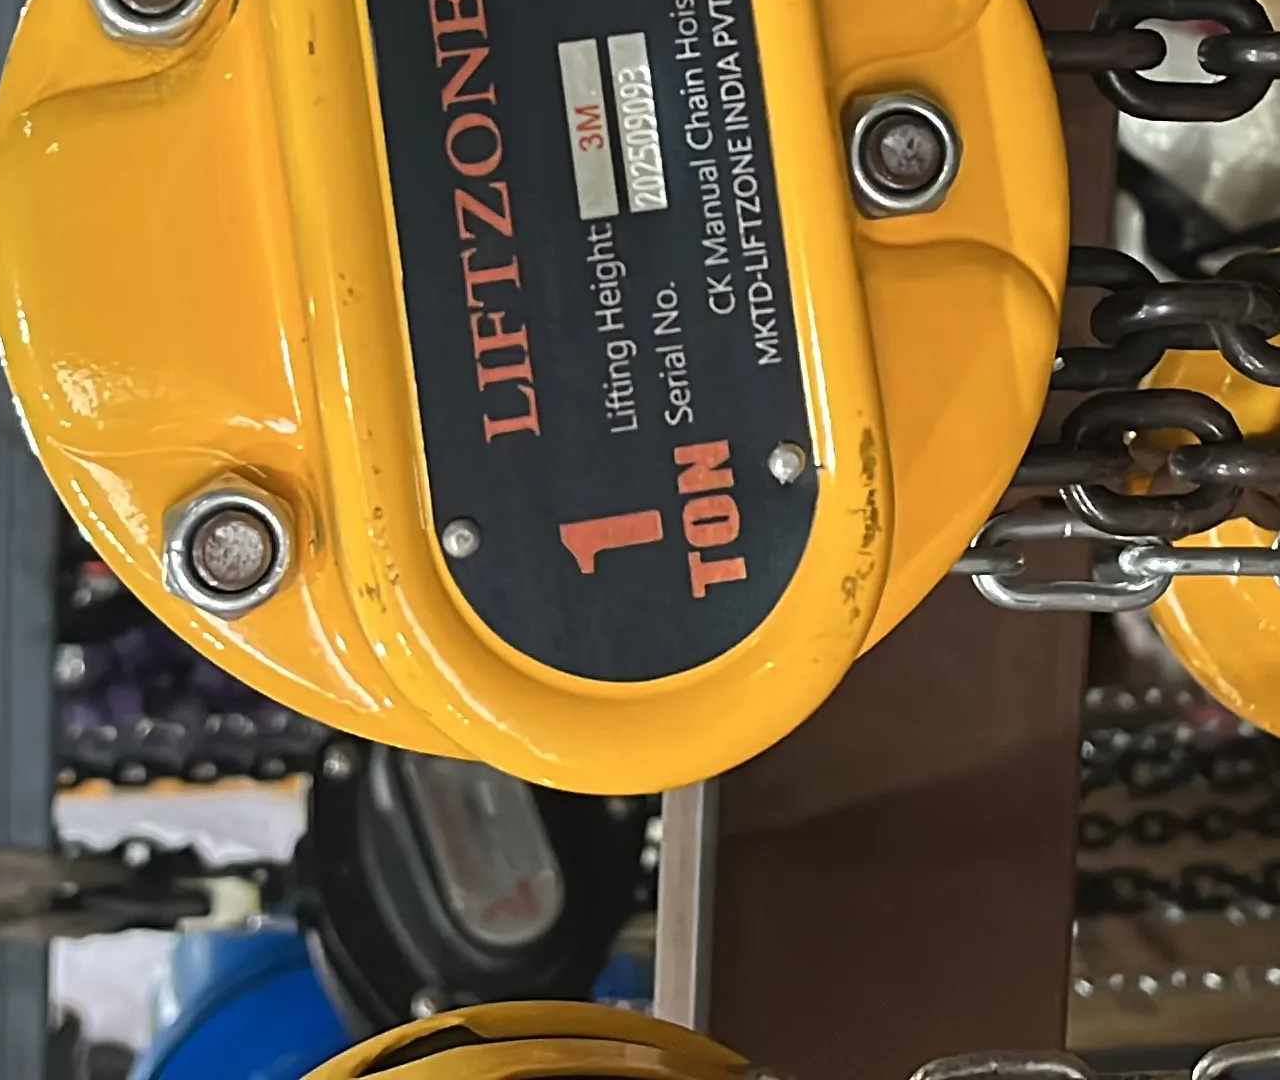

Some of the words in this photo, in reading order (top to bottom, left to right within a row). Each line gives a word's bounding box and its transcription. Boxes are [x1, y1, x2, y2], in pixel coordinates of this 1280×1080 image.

[573, 103, 605, 153] 3M
[678, 67, 715, 151] Chain
[715, 51, 751, 131] INDIA
[688, 158, 729, 266] Manual
[730, 135, 783, 367] MKTD-LIFTZONE
[650, 280, 682, 336] No.
[707, 272, 737, 316] CK
[600, 339, 639, 434] Lifting
[654, 343, 695, 426] Serial
[558, 509, 664, 575] 1
[673, 439, 747, 599] TON
